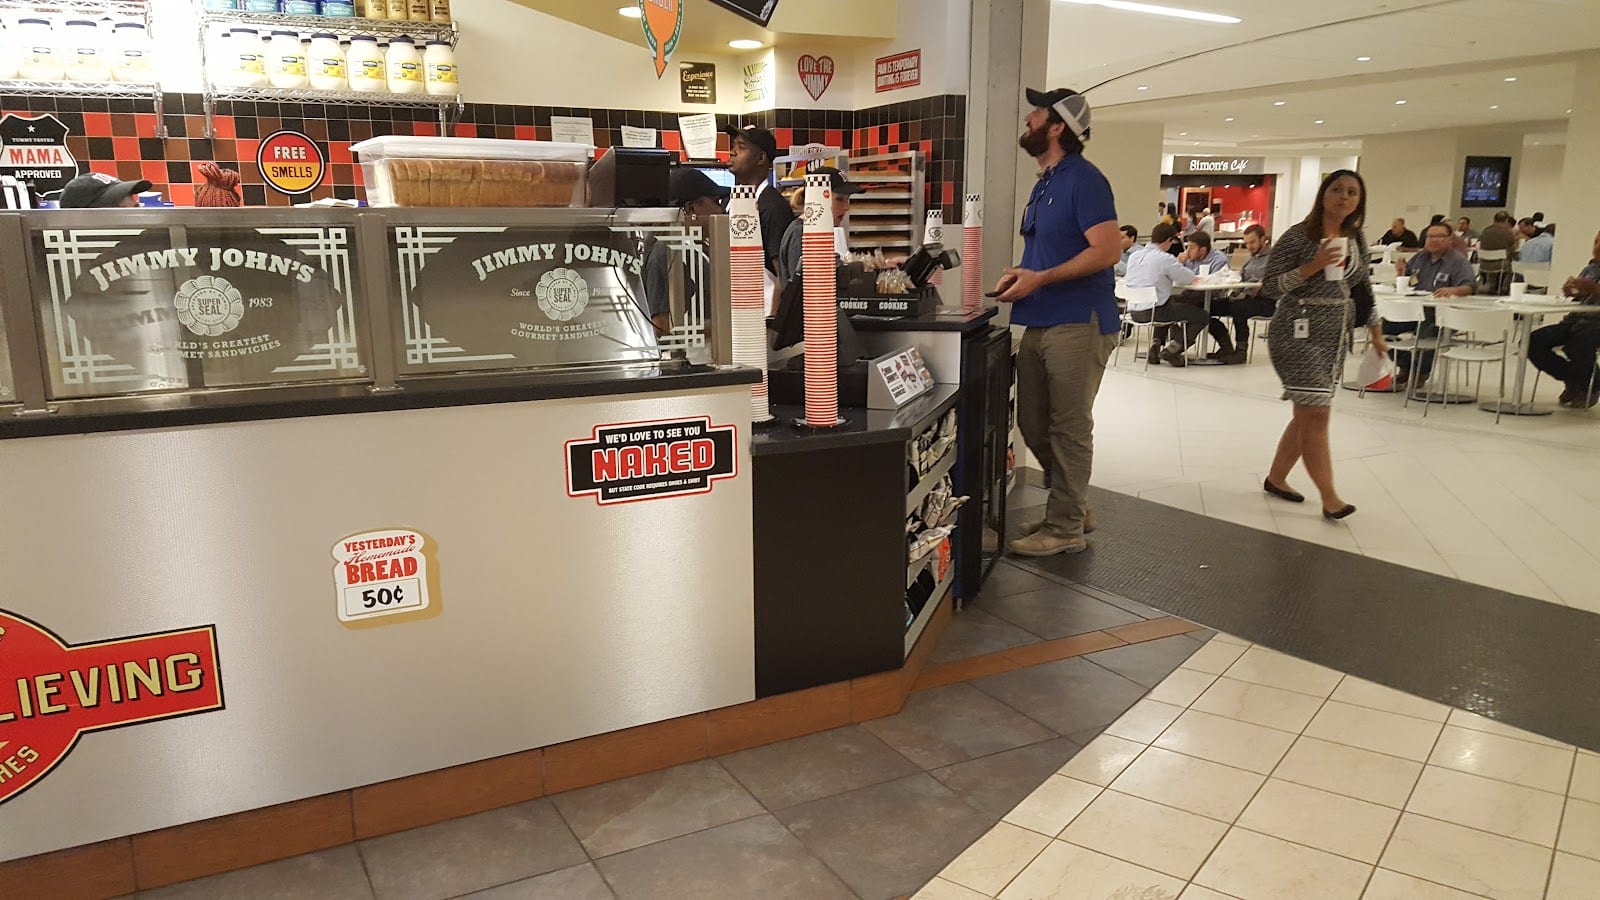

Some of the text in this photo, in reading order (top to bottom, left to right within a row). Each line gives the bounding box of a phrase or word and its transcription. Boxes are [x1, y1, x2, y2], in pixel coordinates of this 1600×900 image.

[800, 56, 833, 74] LOVE THE
[803, 74, 829, 99] JIMMY
[9, 148, 63, 165] MAMA
[273, 146, 307, 160] FREE
[271, 166, 313, 178] SMELLS
[1189, 160, 1228, 171] Simon's
[15, 170, 62, 179] APPROVED
[89, 247, 315, 292] JIMMY JOHN'S
[471, 243, 643, 281] JIMMY JOHN'S
[510, 288, 531, 297] Since
[553, 294, 572, 303] SEAL
[248, 297, 273, 308] 1983
[840, 301, 868, 310] COOKIES
[879, 301, 908, 310] COOKIES
[199, 305, 222, 316] SEAL
[511, 328, 557, 340] GOURMET
[519, 322, 560, 332] WORLD'S
[212, 334, 270, 349] GREATEST
[207, 340, 281, 359] SANDWICHES
[605, 426, 701, 444] WE'D LOVE TO SEE YOU
[592, 438, 716, 482] NAKED
[344, 534, 416, 553] YESTERDAY'S
[344, 544, 416, 565] Homemade
[346, 556, 418, 585] BREAD
[362, 585, 404, 608] 50¢
